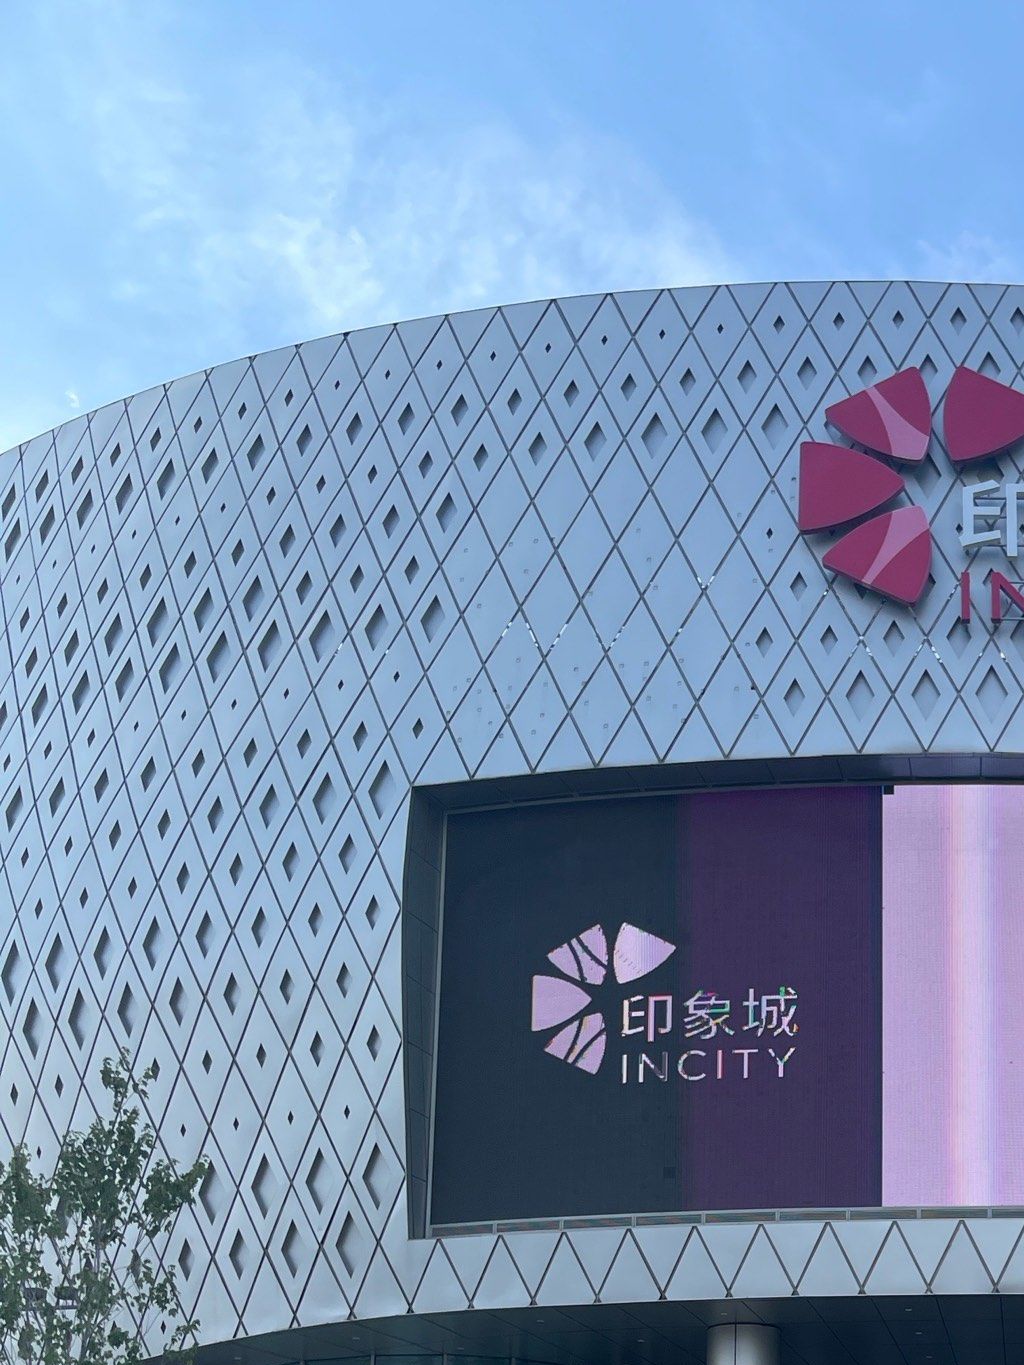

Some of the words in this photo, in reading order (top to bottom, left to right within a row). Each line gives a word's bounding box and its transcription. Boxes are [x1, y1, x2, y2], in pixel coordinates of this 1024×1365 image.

[621, 986, 798, 1042] 印象城
[621, 1047, 796, 1084] INCITY
